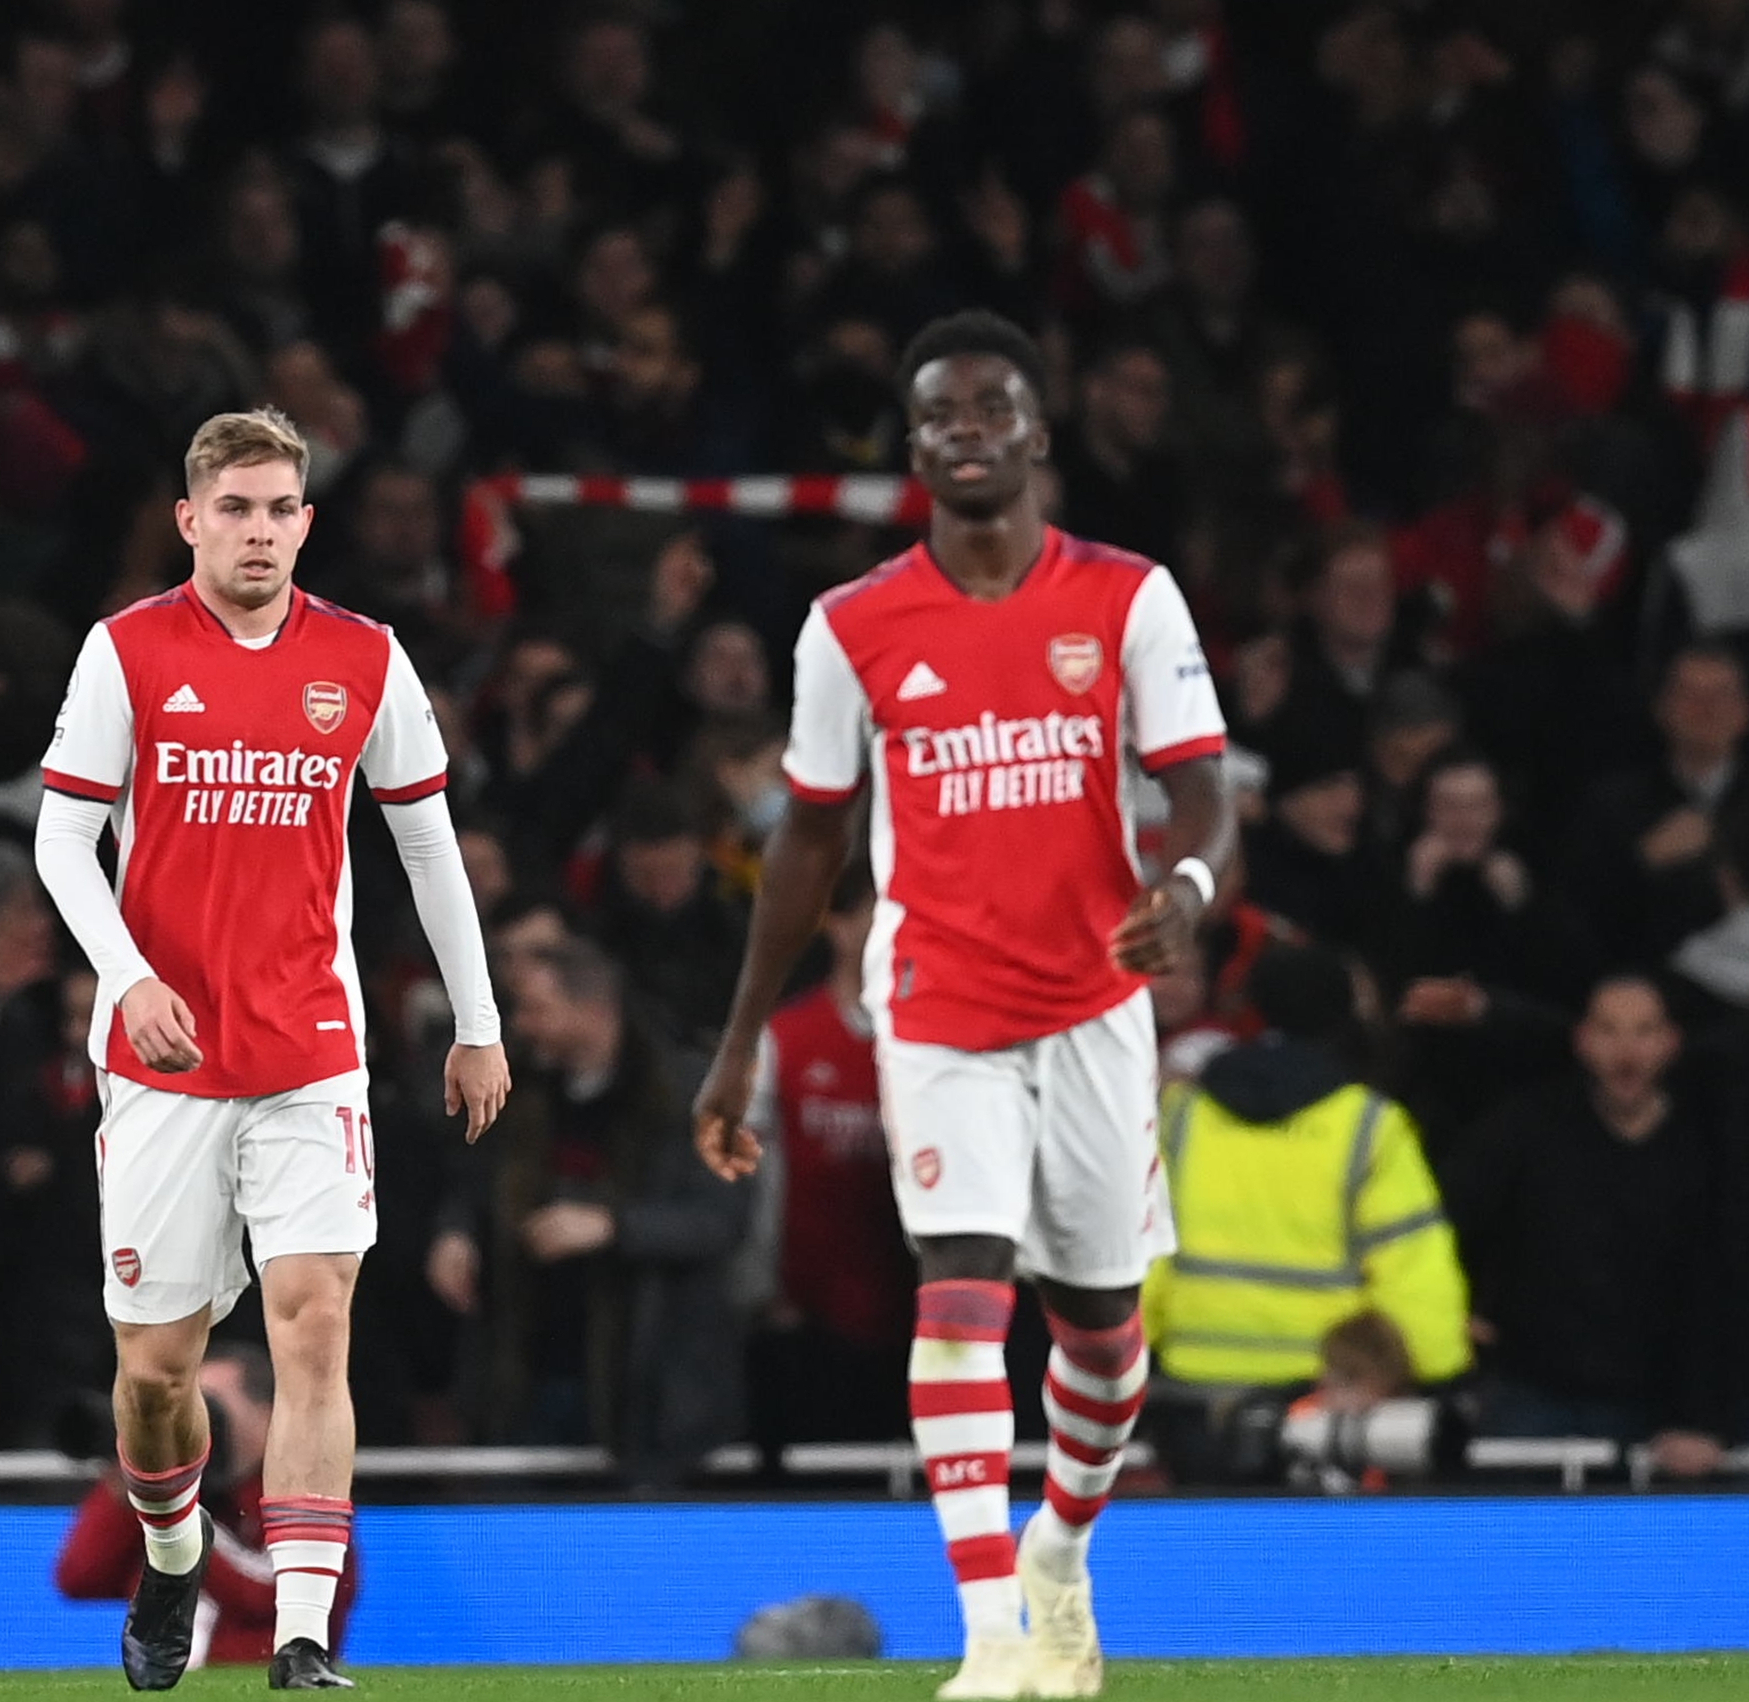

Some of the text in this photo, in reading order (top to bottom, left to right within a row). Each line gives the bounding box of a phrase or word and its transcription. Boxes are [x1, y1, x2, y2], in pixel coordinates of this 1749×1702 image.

[155, 740, 342, 790] Emirates
[904, 709, 1103, 778] Emirates
[184, 789, 312, 827] FLY BETTER
[938, 757, 1086, 818] FLY BETTER
[935, 1459, 987, 1486] AFC
